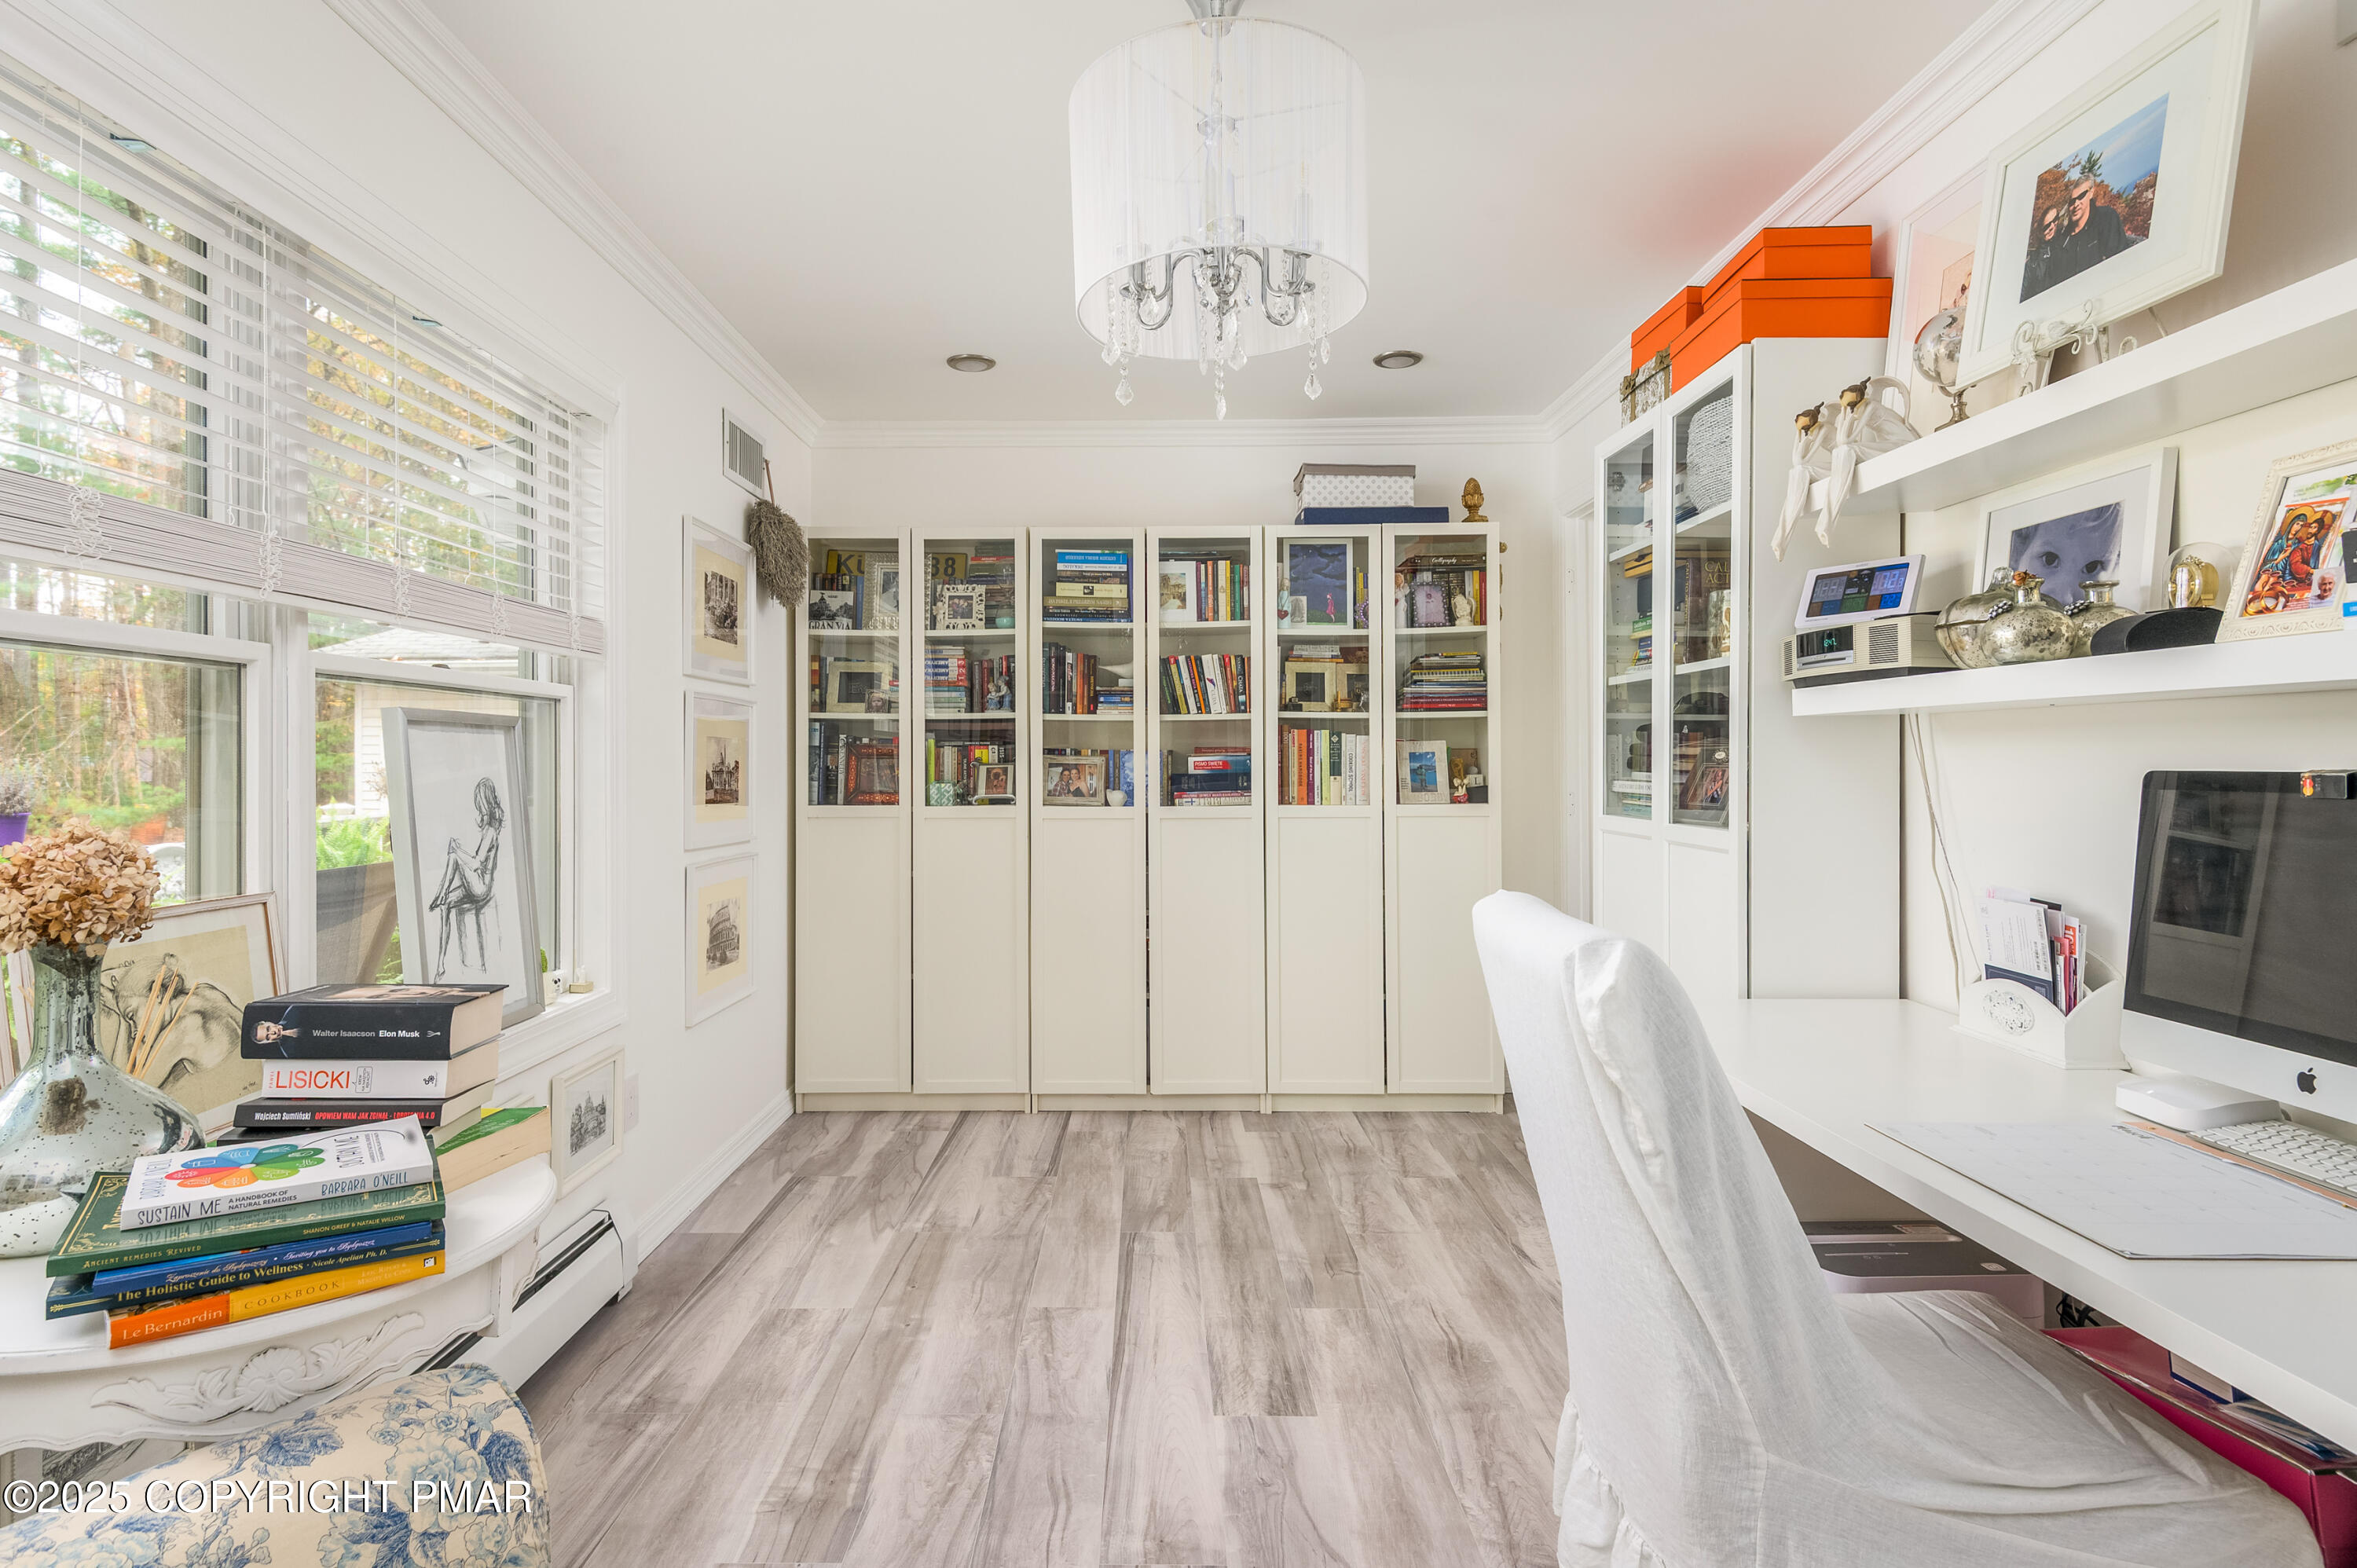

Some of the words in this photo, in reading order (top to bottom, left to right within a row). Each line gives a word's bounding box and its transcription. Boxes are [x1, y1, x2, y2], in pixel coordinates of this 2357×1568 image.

[312, 1029, 339, 1038] Walter
[339, 1029, 376, 1038] Isaacson
[275, 1070, 350, 1090] LISICKI
[255, 1112, 281, 1121] Wojciech
[282, 1112, 311, 1120] Sumliński
[315, 1112, 343, 1120] OPOWIEM
[321, 1178, 367, 1196] BARBARA
[373, 1171, 409, 1188] O'NEILL
[228, 1201, 262, 1211] NATURAL
[262, 1195, 298, 1206] REMEDIES
[235, 1191, 277, 1203] HANDBOOK
[137, 1203, 192, 1225] SUSTAIN
[200, 1199, 222, 1215] ME
[302, 1226, 330, 1235] SHANON
[331, 1222, 351, 1231] GREEF
[357, 1218, 380, 1227] NATALIE
[381, 1214, 405, 1223] WILLOW
[311, 1258, 336, 1268] Nicole
[335, 1253, 364, 1265] Apelian
[115, 1291, 141, 1302] The
[145, 1280, 196, 1298] Holistic
[198, 1273, 236, 1288] Guide
[239, 1270, 251, 1281] to
[254, 1262, 304, 1278] Wellness
[244, 1280, 341, 1310] COOKBOOK
[123, 1328, 141, 1340] Le
[145, 1308, 223, 1335] Bernardin
